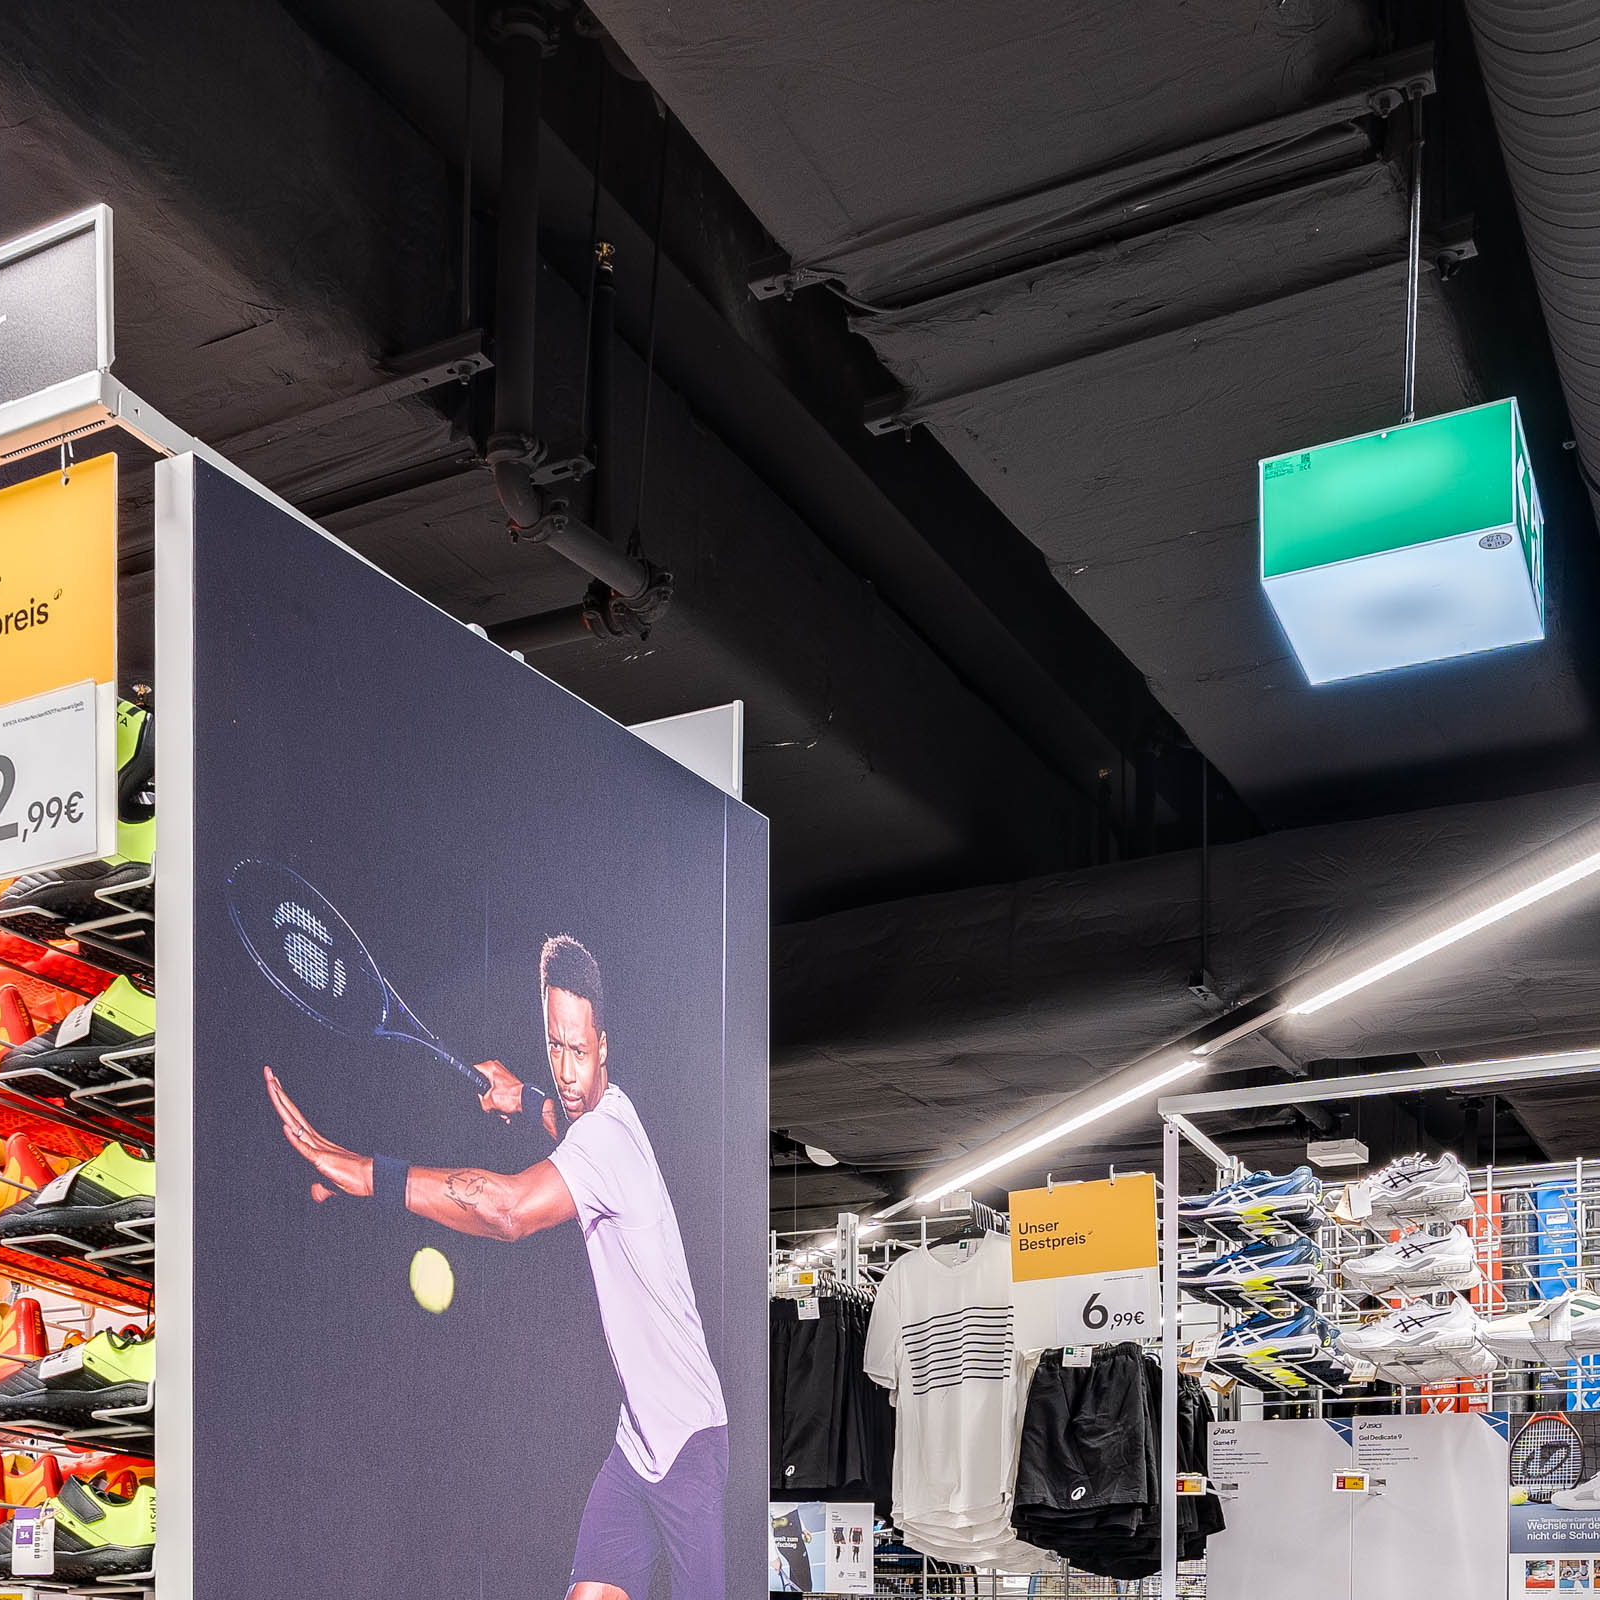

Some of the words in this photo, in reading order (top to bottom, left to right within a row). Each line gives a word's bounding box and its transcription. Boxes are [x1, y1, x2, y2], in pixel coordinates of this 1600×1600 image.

[1018, 1221, 1060, 1235] Unser
[1019, 1232, 1086, 1251] Bestpreis
[1082, 1292, 1145, 1331] 6,99€
[1370, 1433, 1398, 1441] Dedicate
[1527, 1521, 1567, 1531] Wechsle
[1569, 1522, 1585, 1530] nur
[1527, 1532, 1550, 1540] nicht
[1551, 1531, 1566, 1540] die
